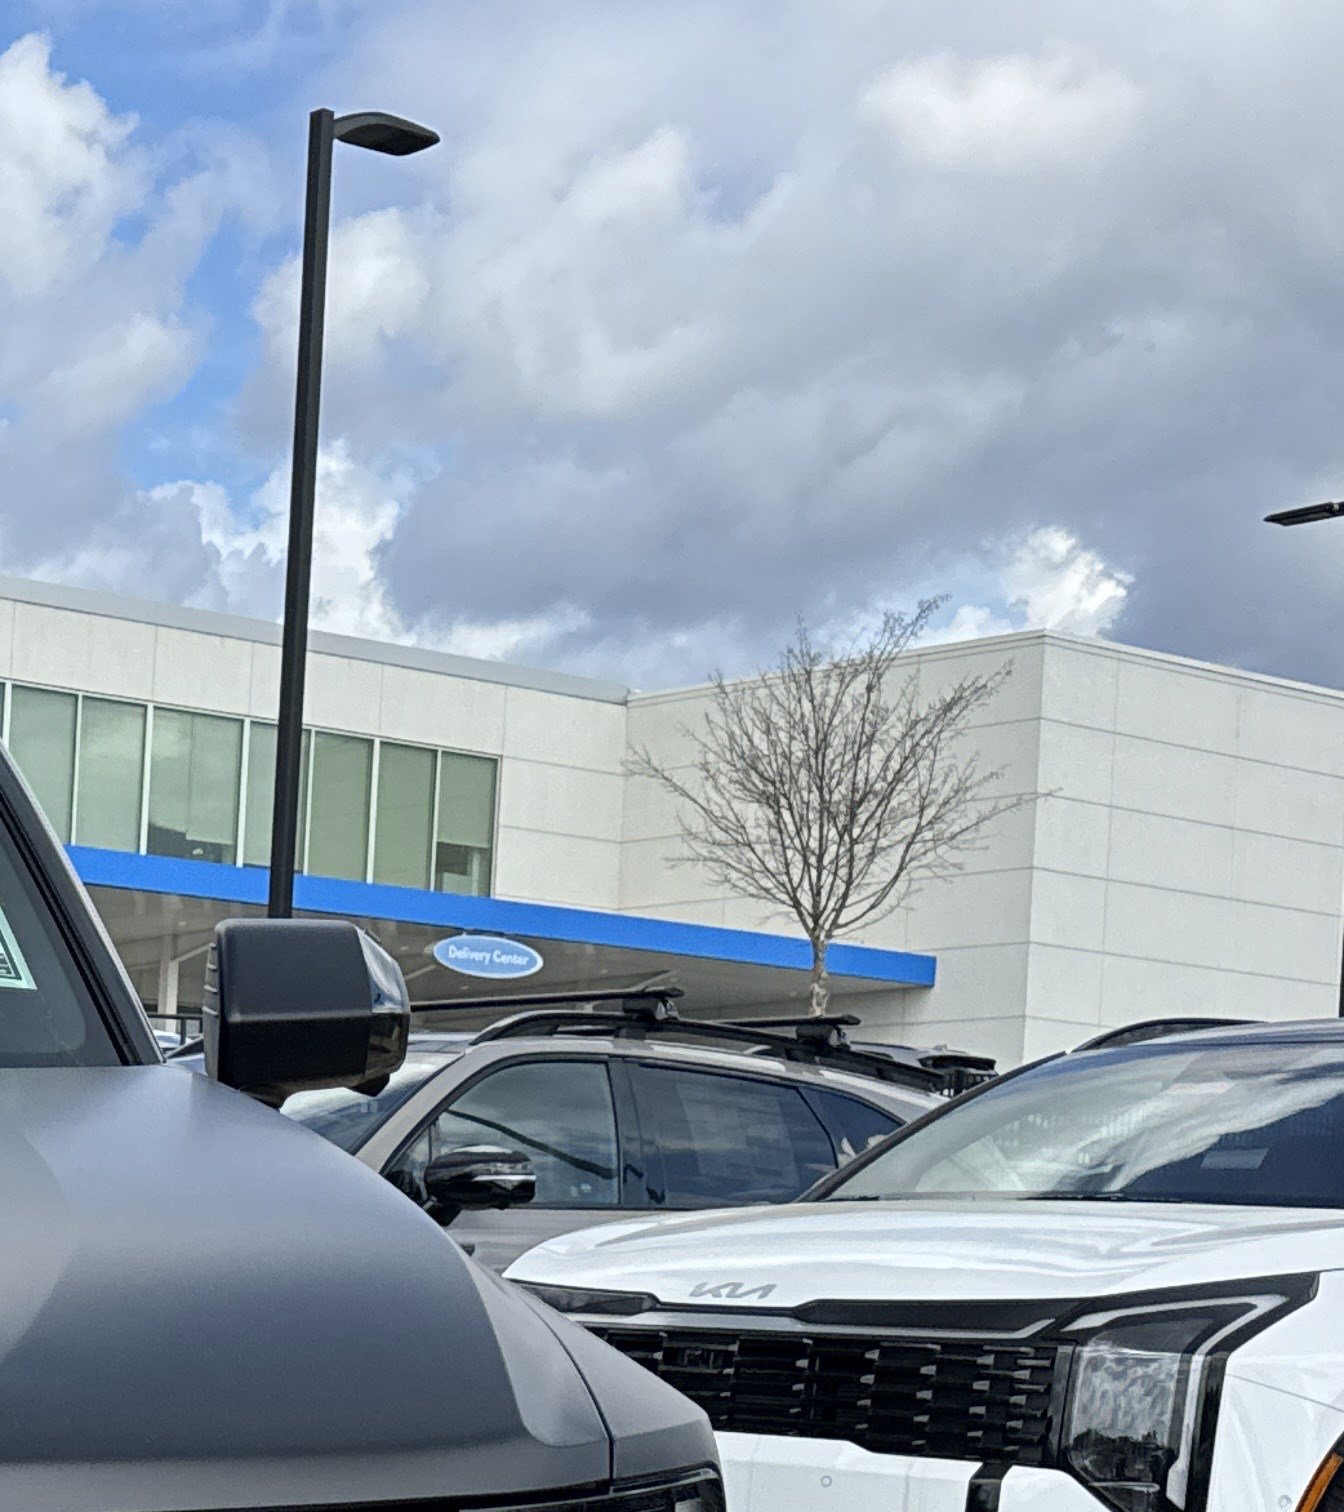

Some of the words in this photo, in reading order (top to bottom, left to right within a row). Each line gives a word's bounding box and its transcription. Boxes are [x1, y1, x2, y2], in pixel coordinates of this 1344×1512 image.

[448, 944, 491, 965] Delivery
[493, 949, 529, 966] Center
[688, 1281, 778, 1300] KIA
